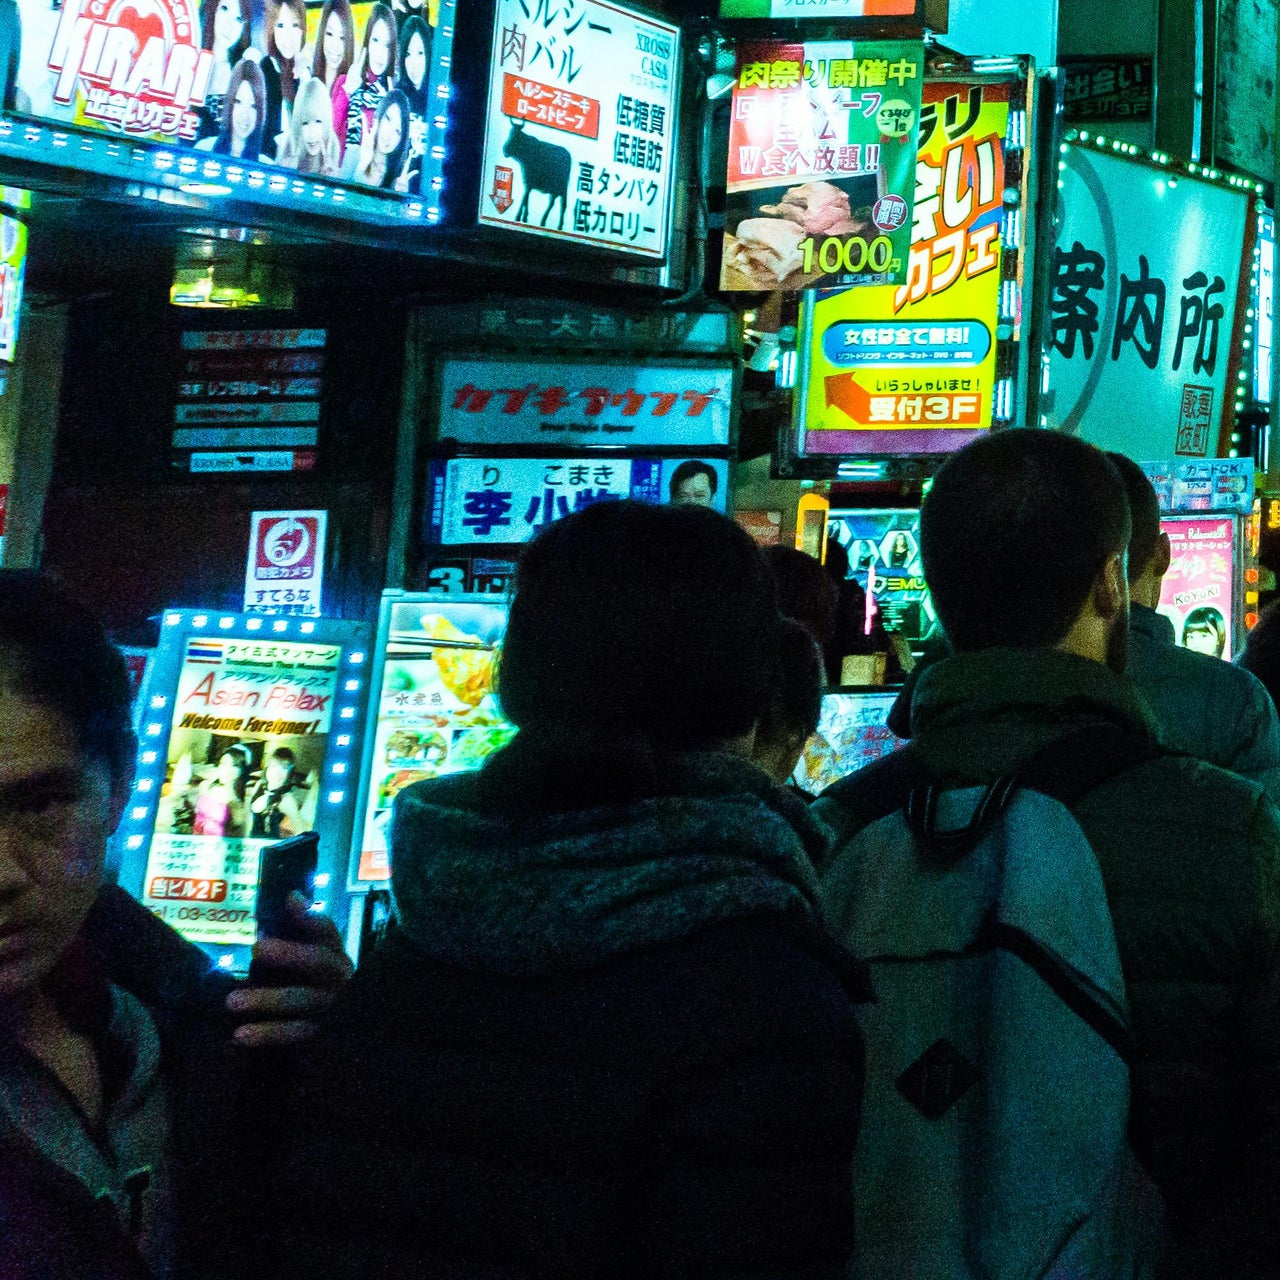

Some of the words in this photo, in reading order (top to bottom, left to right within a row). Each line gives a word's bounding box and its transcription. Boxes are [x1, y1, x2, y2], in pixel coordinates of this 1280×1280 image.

[500, 23, 583, 84] 肉バル
[739, 58, 918, 89] 肉祭り開催中
[616, 93, 666, 137] 低糖質
[613, 131, 663, 174] 低脂肪
[577, 161, 659, 207] 高タンパク
[573, 198, 657, 242] 低カロリー
[893, 225, 1001, 315] カフェ
[1048, 240, 1229, 377] 案内所
[876, 379, 981, 392] いらっしゃいませ！
[869, 396, 977, 422] 受付3F
[543, 465, 615, 486] こまき
[464, 490, 511, 534] 李
[178, 712, 242, 732] Welcome
